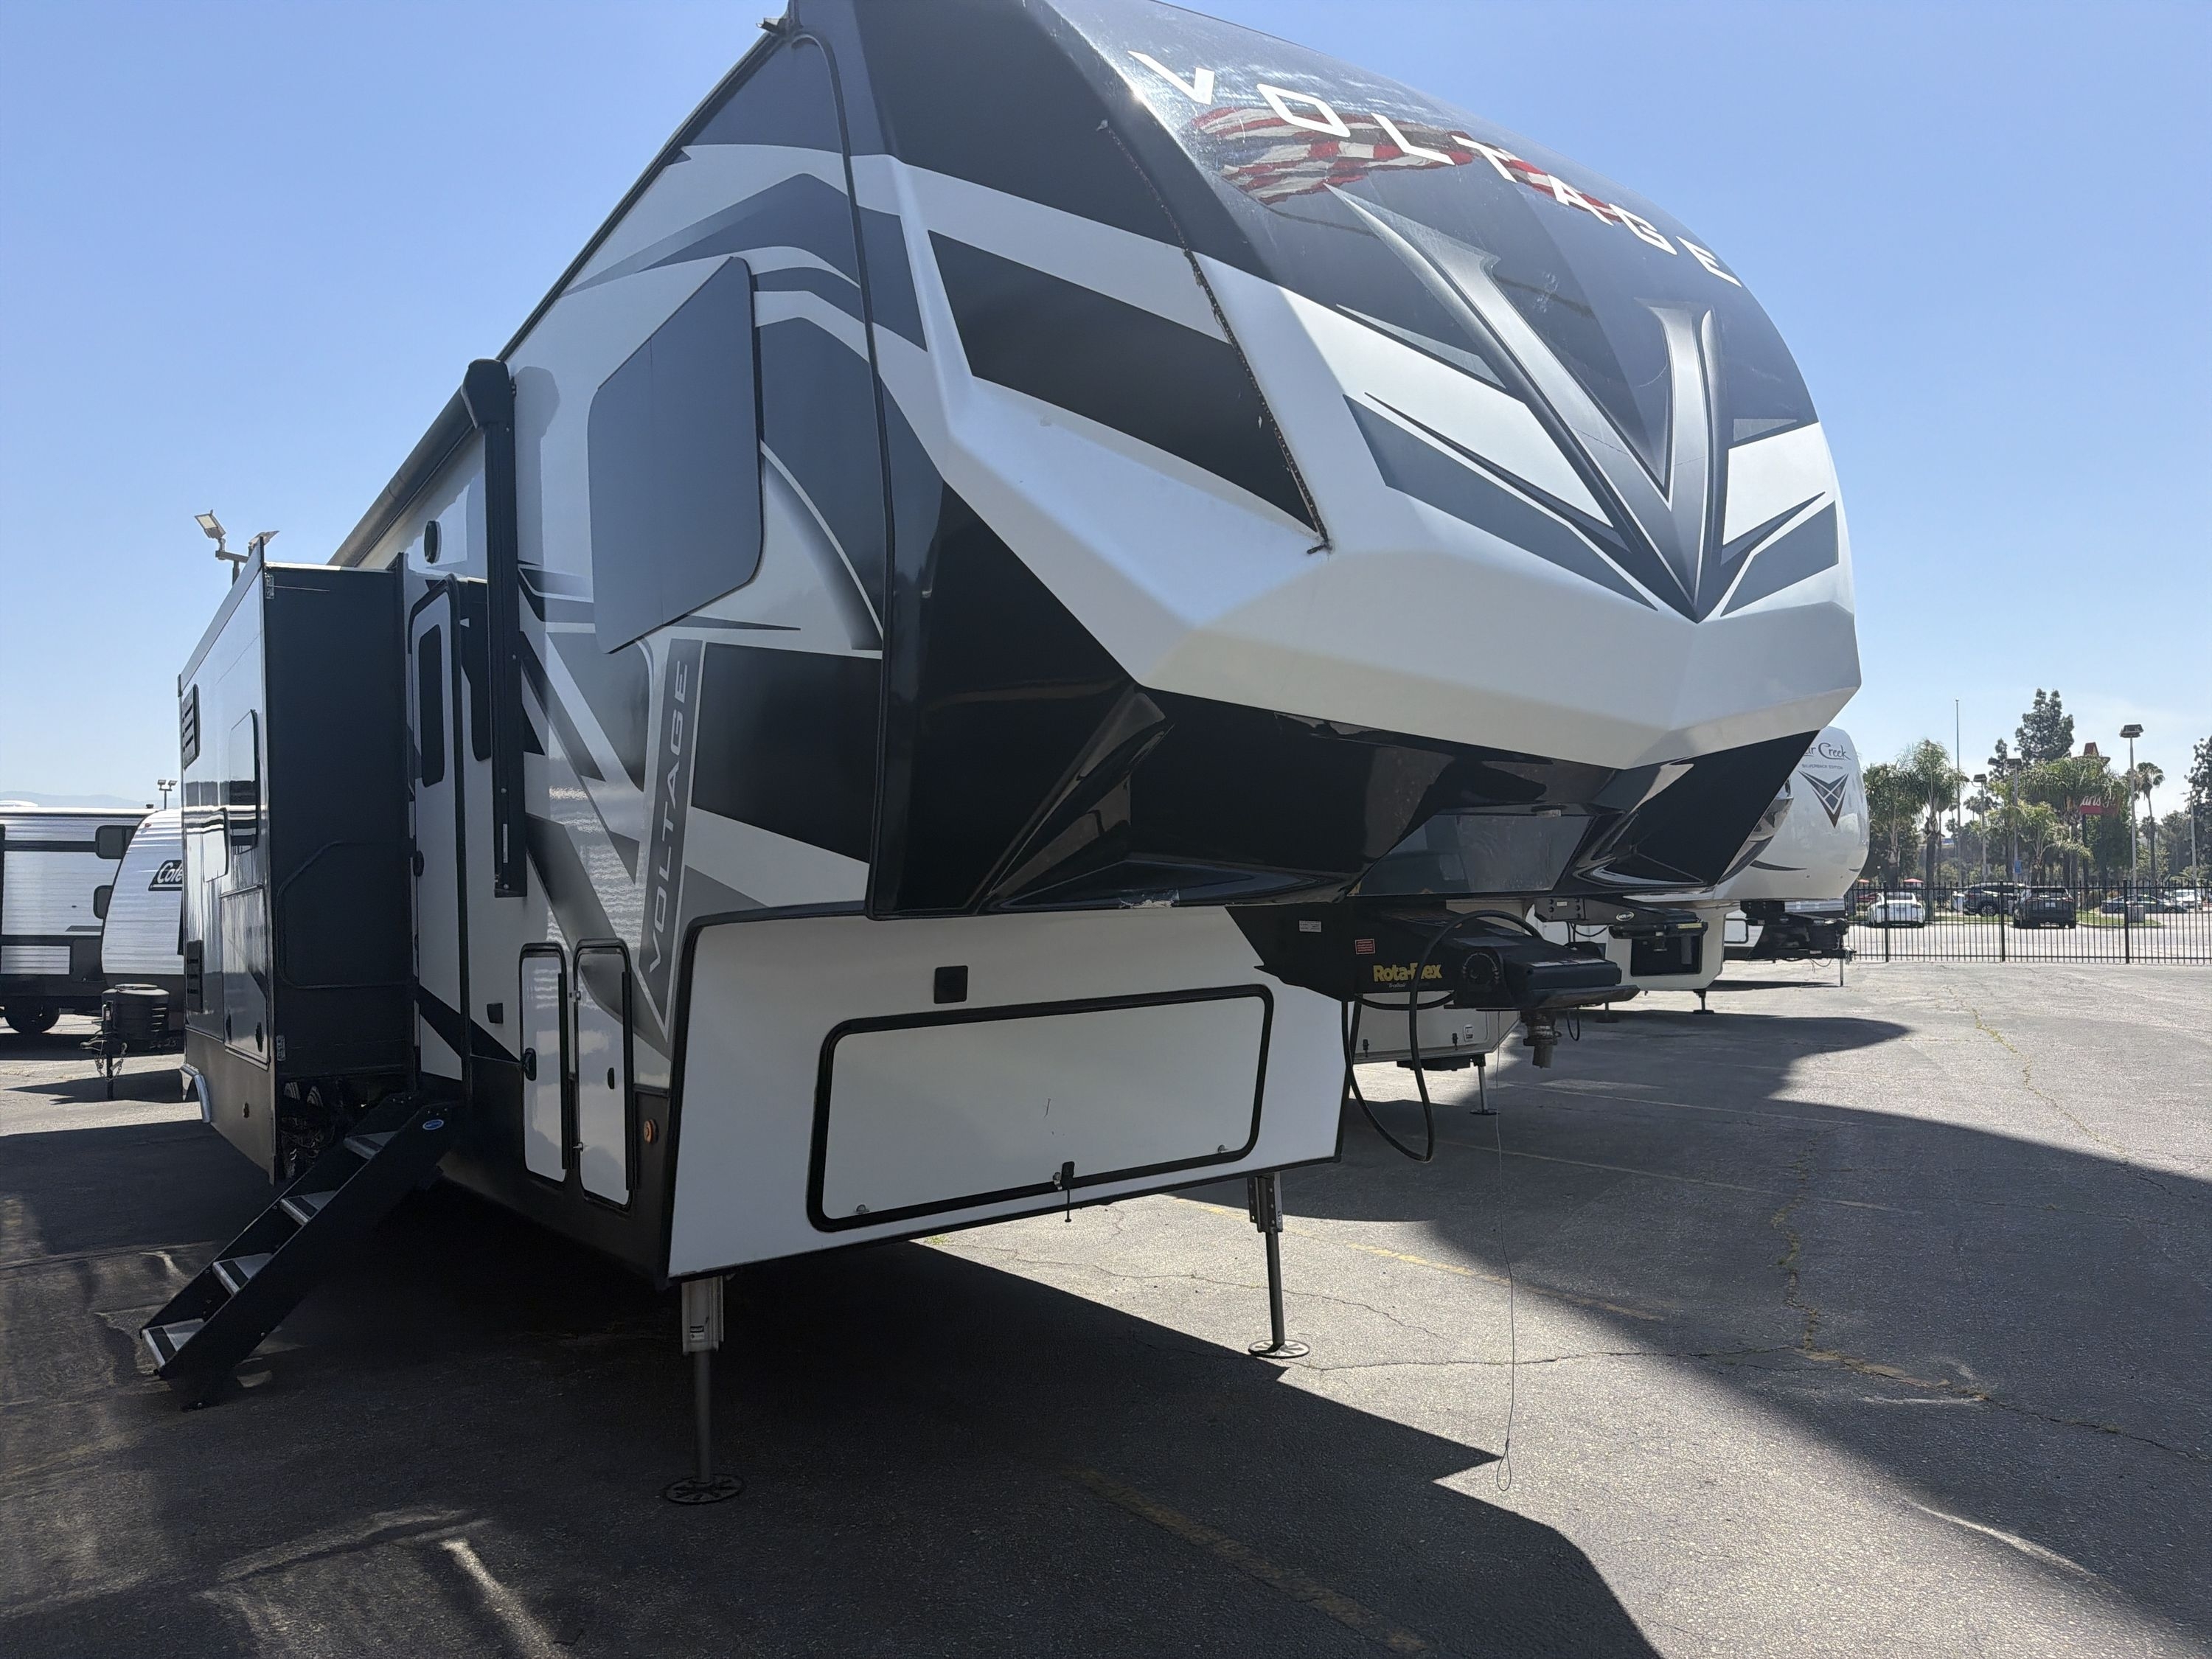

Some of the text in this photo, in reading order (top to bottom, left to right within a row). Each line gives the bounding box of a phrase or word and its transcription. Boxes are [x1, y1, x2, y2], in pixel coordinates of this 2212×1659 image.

[1128, 50, 1742, 287] VOLTAGE
[1818, 742, 1851, 760] Creek
[157, 862, 182, 883] Cole
[650, 661, 687, 973] VOLTAGE
